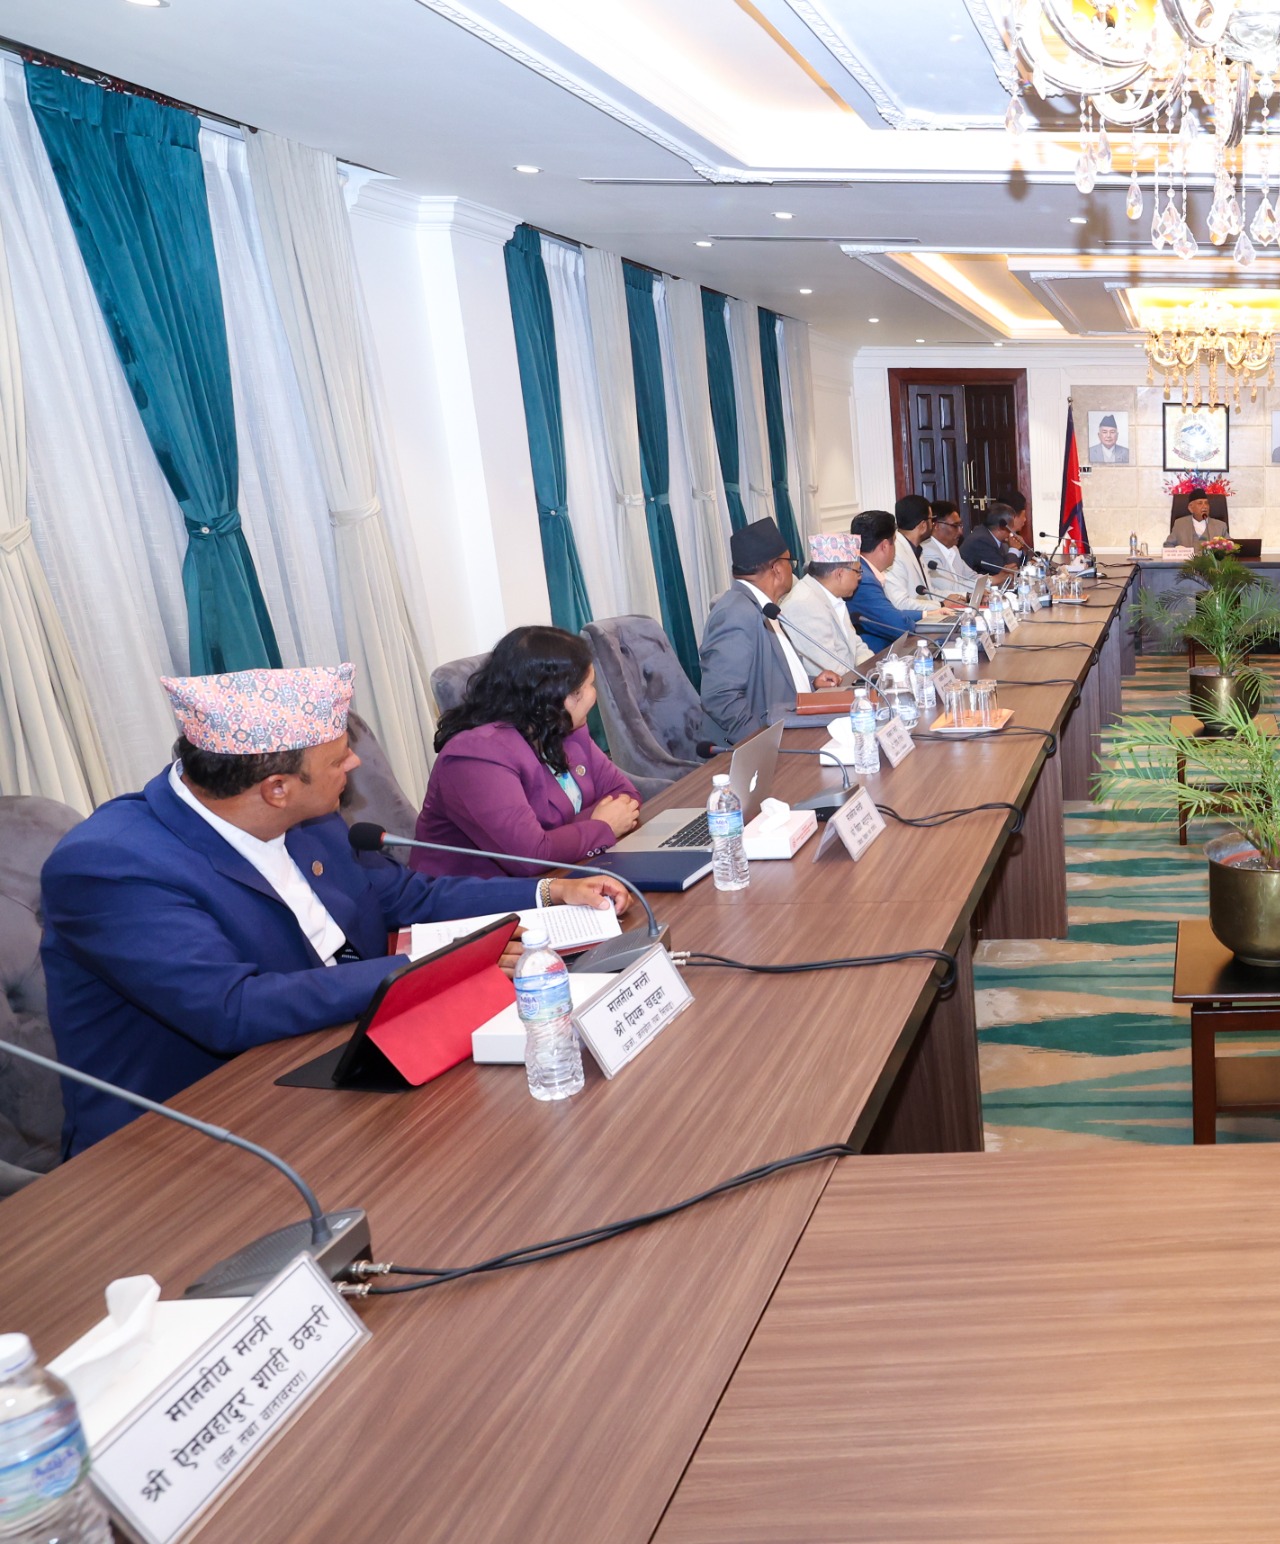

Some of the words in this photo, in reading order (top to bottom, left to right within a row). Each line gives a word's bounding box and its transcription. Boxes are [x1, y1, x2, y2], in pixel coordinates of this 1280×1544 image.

[607, 987, 633, 1013] माननीय
[633, 970, 651, 990] मन्त्री
[613, 1019, 626, 1037] श्री
[623, 1004, 645, 1027] दिपक
[140, 1468, 172, 1503] श्री
[170, 1387, 254, 1470] ऐनबहादुर
[250, 1347, 290, 1390] शाही
[288, 1304, 330, 1350] ठकुरी
[165, 1356, 232, 1422] माननीय
[232, 1315, 274, 1356] मन्त्री
[237, 1421, 261, 1446] तथा
[259, 1369, 309, 1421] वातावरण)
